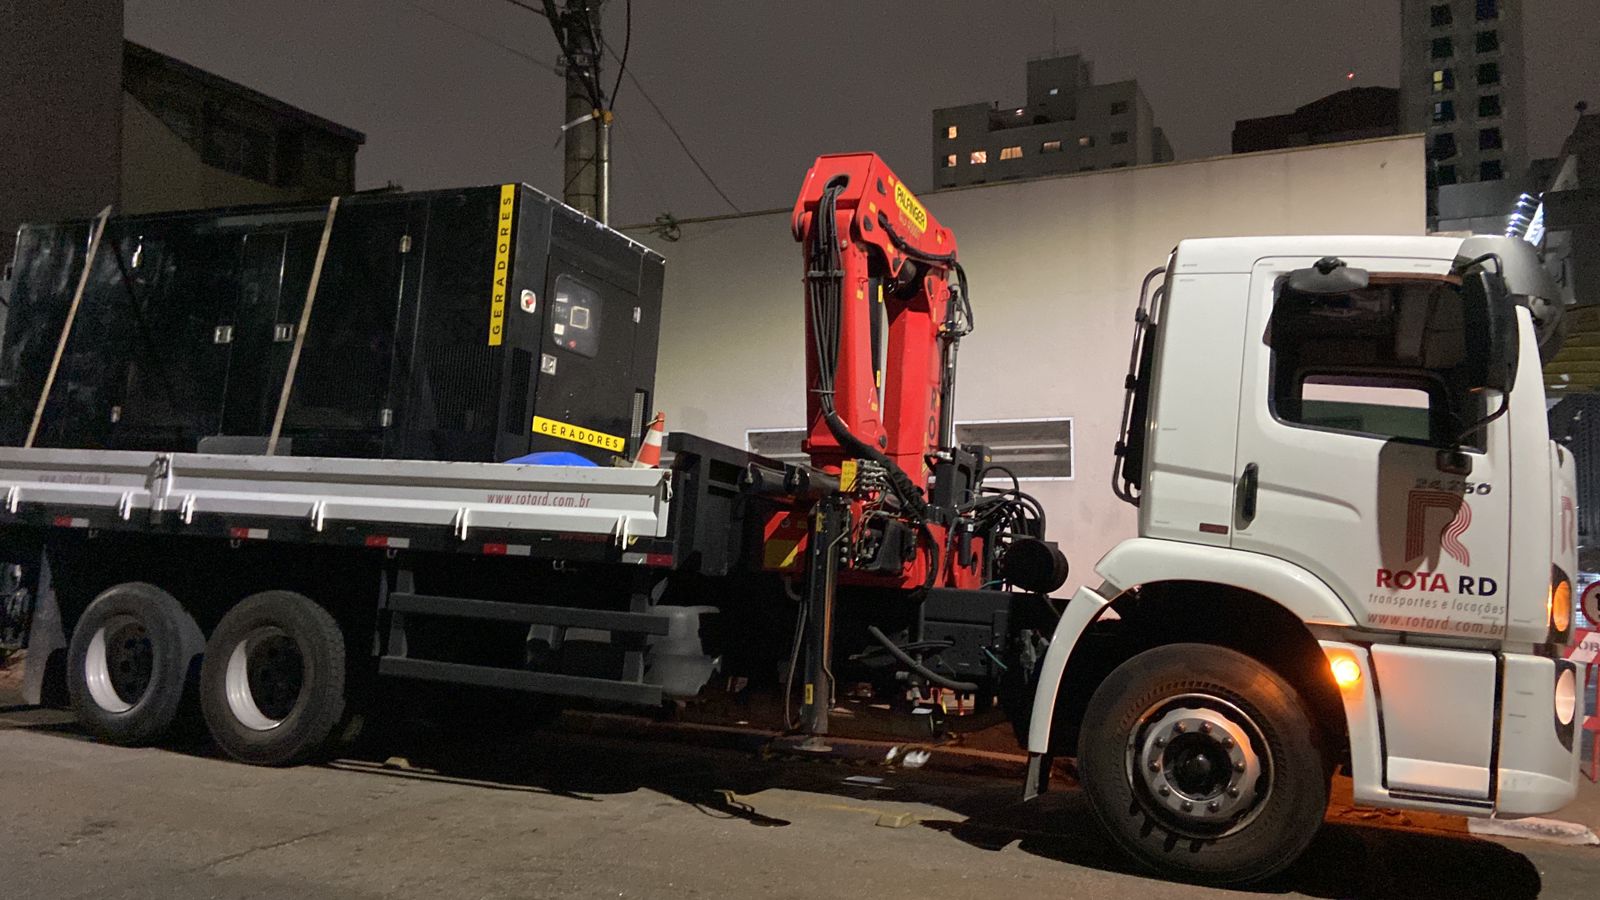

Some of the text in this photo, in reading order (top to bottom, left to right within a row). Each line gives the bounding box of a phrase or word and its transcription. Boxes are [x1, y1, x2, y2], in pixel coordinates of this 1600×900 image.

[492, 197, 512, 335] GERADORES
[541, 422, 618, 448] GERADORES
[487, 492, 591, 508] www.rotard.com.br
[1376, 568, 1497, 596] ROTA RD
[1368, 593, 1505, 617] transportes e locações
[1367, 612, 1507, 635] www.rotard.com.br
